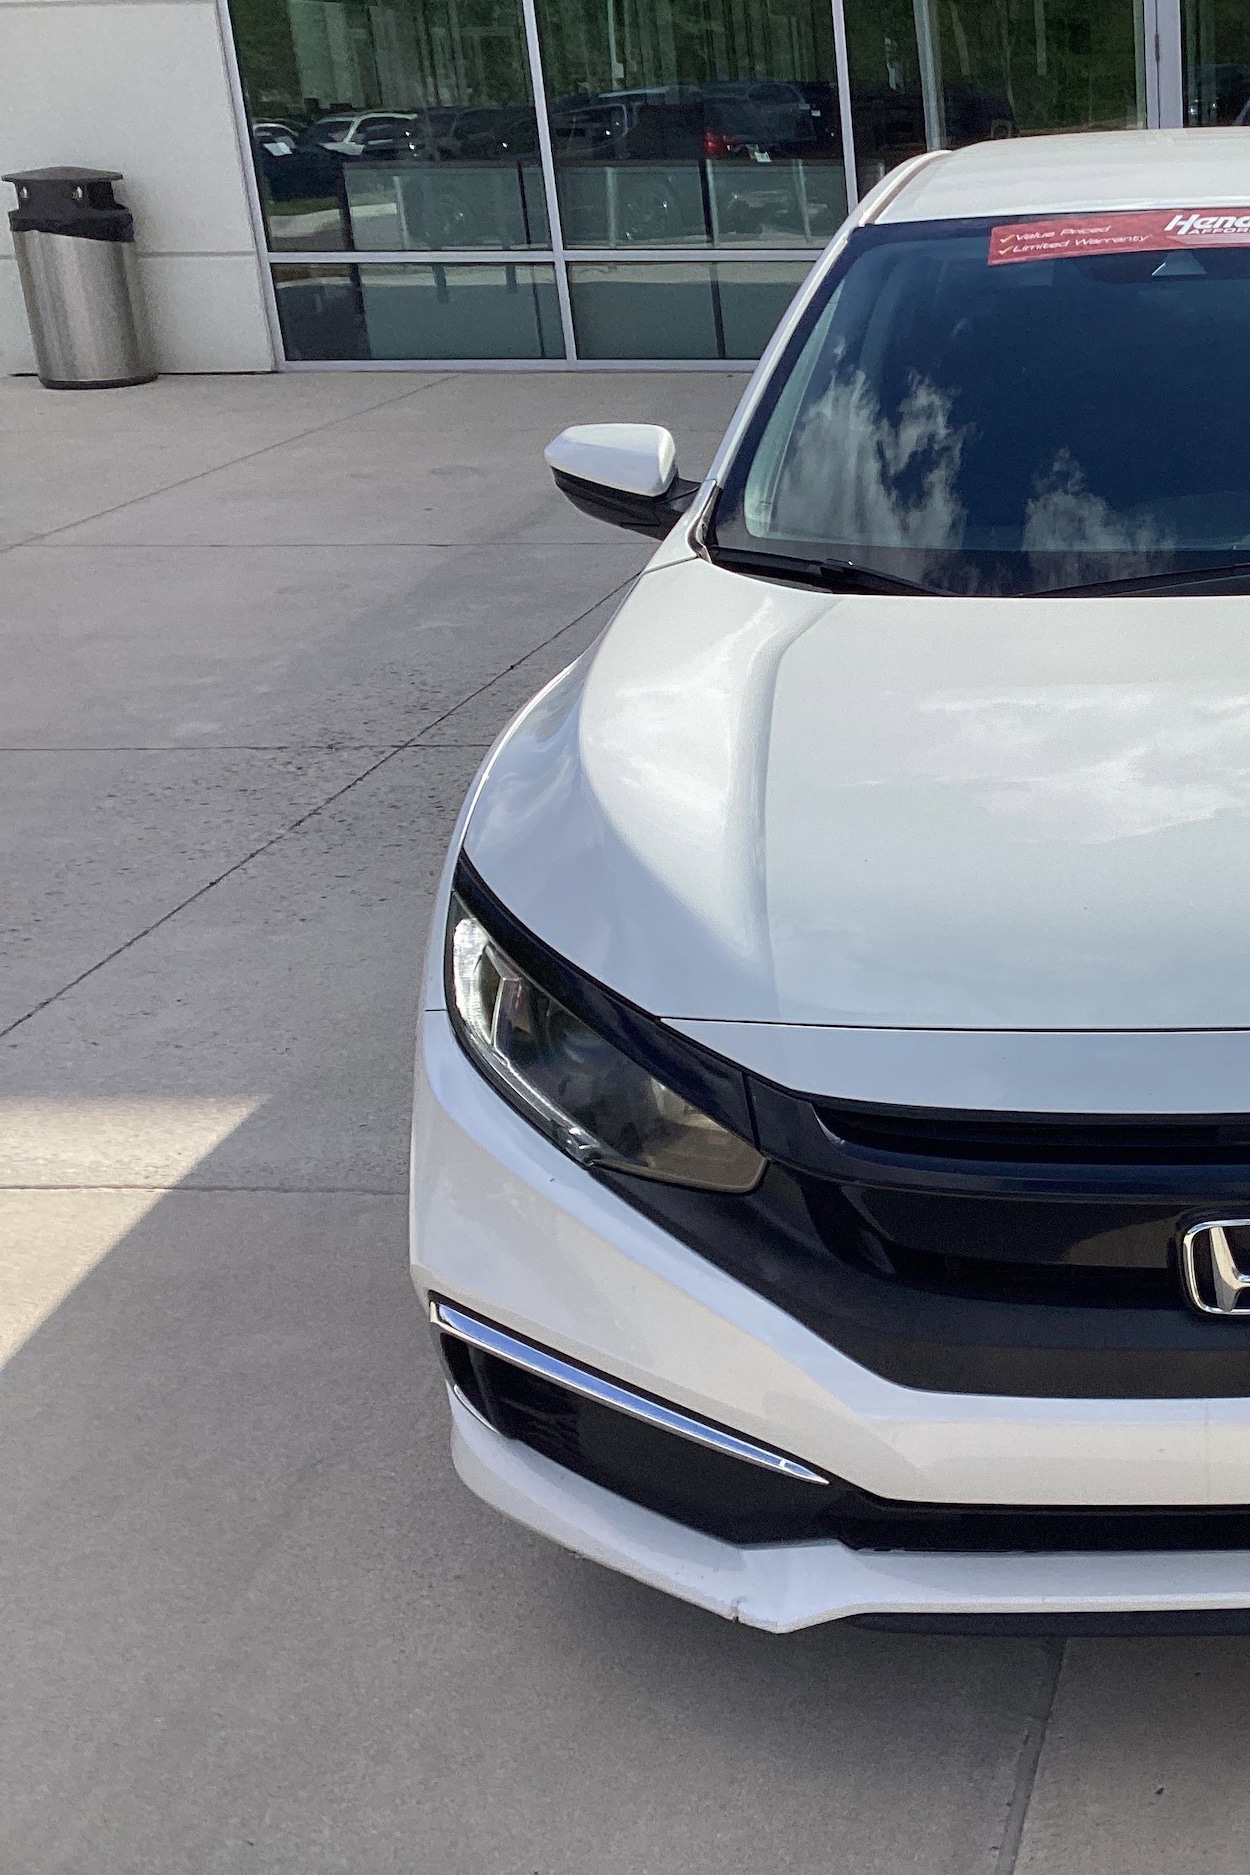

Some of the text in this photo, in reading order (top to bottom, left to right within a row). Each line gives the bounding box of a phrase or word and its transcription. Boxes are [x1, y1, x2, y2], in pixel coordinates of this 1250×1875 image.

[1015, 225, 1111, 241] Value Priced
[1012, 234, 1149, 253] Limited Warranty
